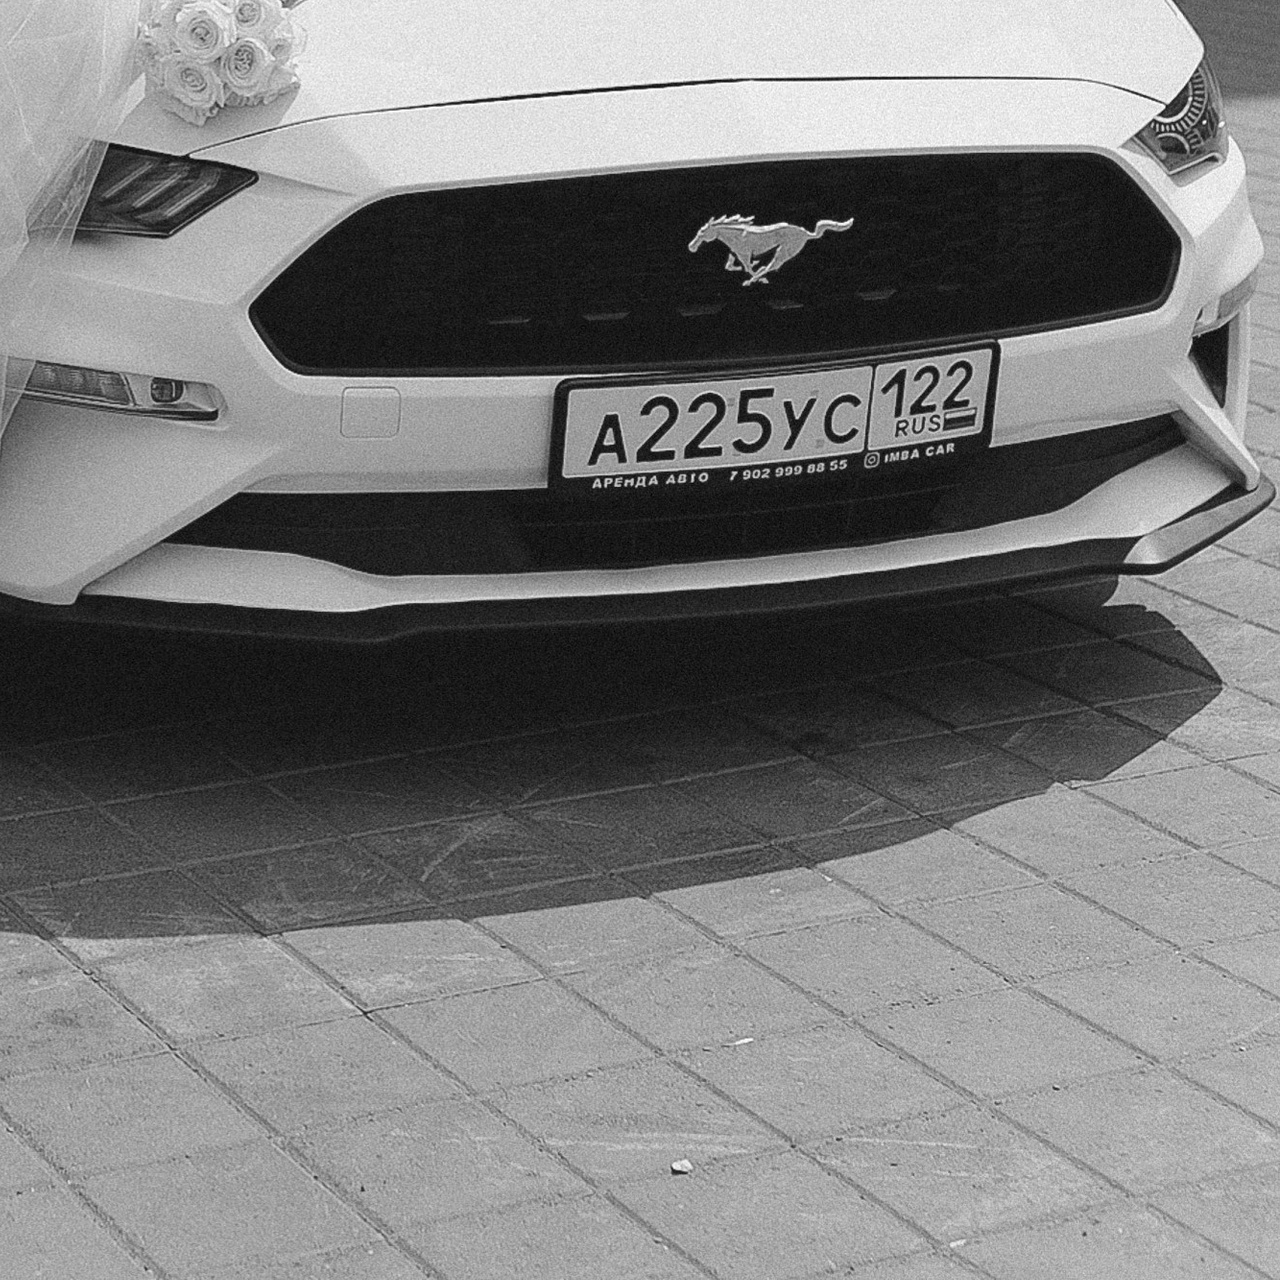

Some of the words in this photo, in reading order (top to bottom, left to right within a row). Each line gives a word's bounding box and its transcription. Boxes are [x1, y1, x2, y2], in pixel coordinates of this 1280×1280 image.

[587, 387, 862, 466] А225УС
[881, 359, 974, 419] 122
[894, 414, 941, 438] RUS
[592, 476, 659, 489] АРЕНДА
[666, 472, 709, 485] АВТО
[742, 468, 771, 481] 902
[775, 465, 803, 478] 999
[807, 462, 826, 474] 88
[829, 458, 848, 471] 55
[925, 443, 955, 457] CAR
